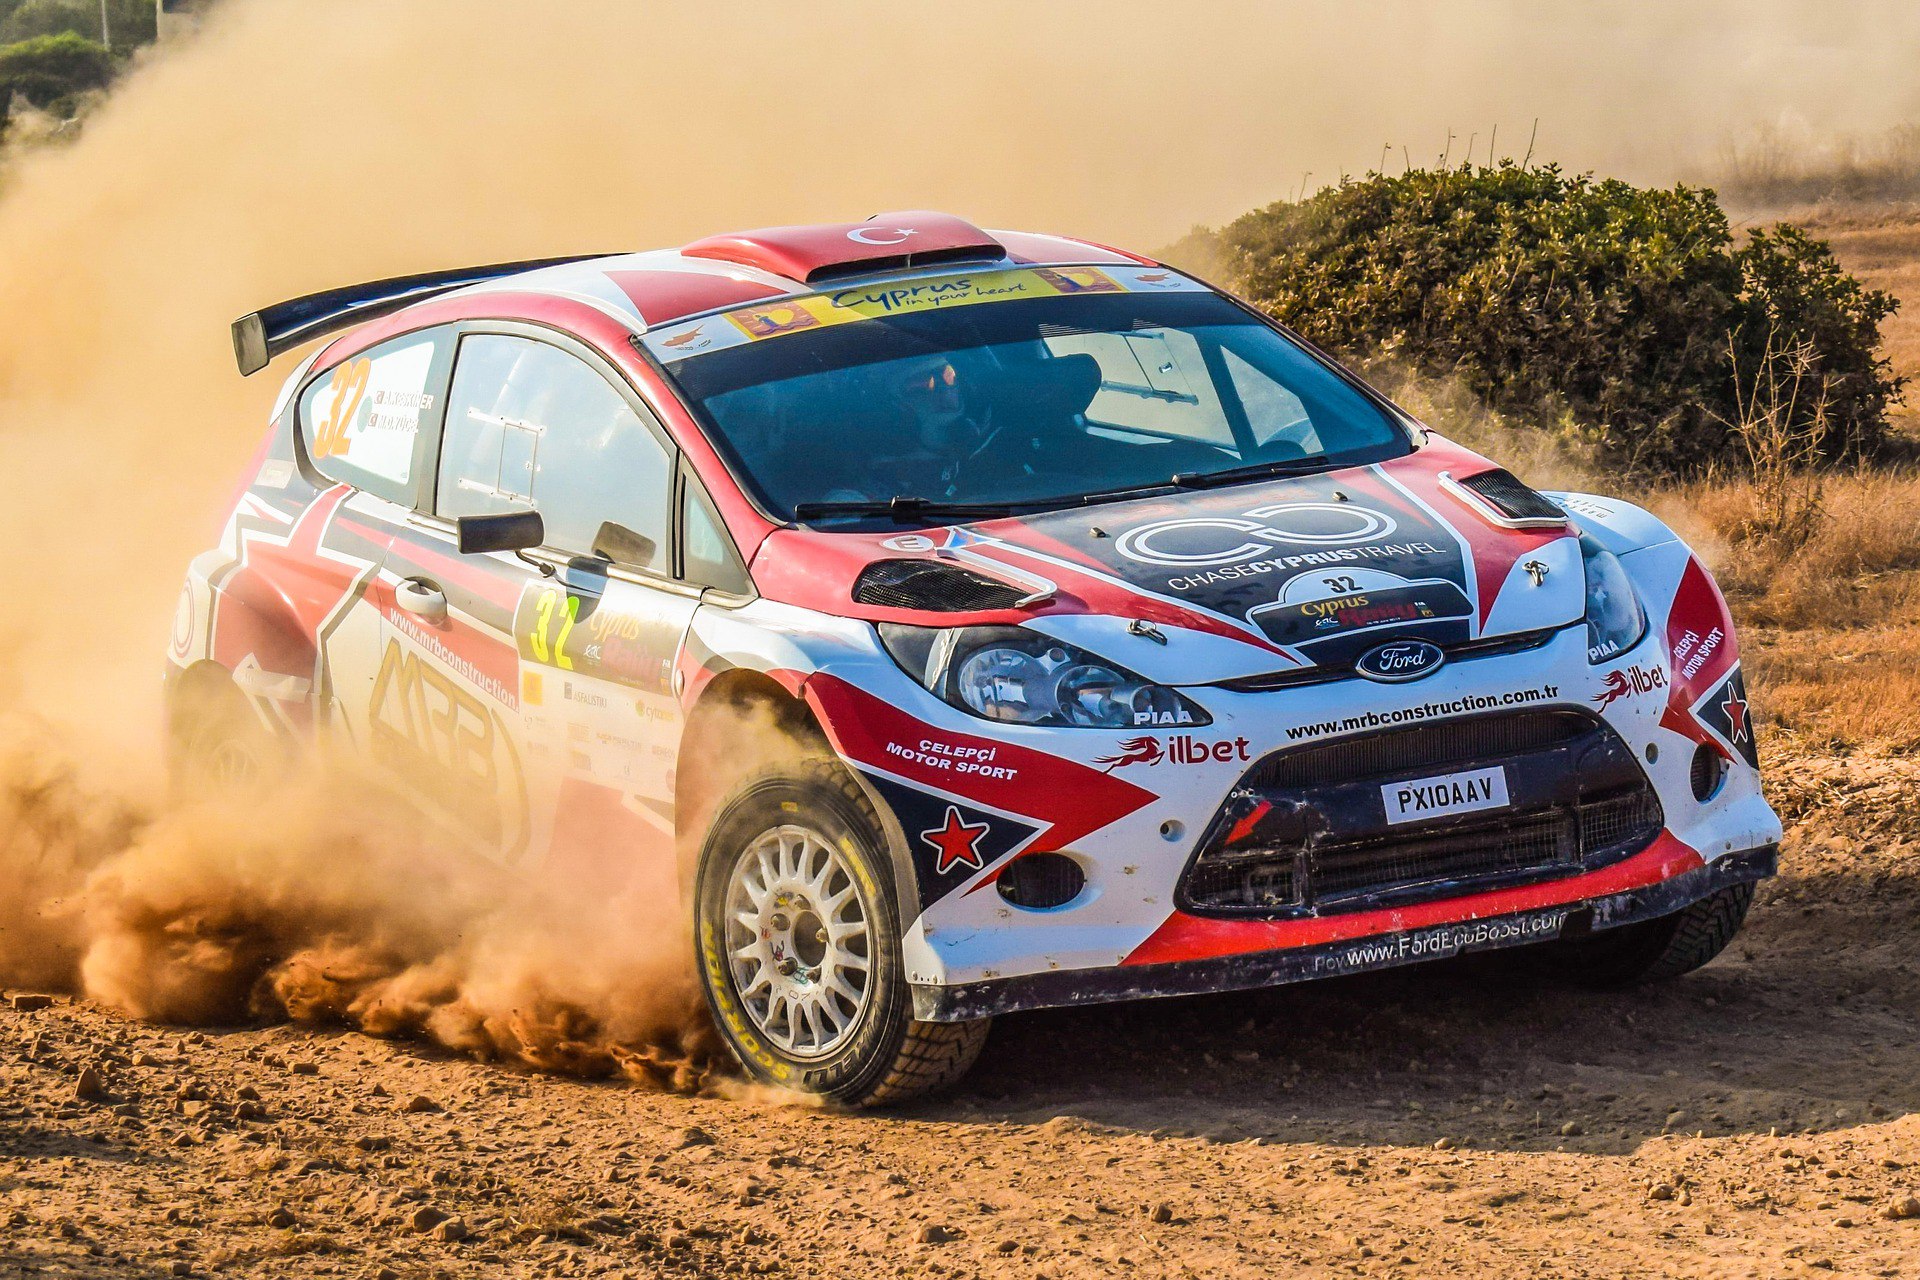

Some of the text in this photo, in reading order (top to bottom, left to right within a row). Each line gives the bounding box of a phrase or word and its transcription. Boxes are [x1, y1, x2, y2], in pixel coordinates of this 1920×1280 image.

[831, 279, 972, 311] Cyprus
[906, 283, 1027, 307] in your heart
[313, 357, 371, 459] 32
[1167, 542, 1447, 591] CHASECYPRUSTRAVEL
[1322, 576, 1364, 593] 32
[1300, 595, 1369, 618] Cyprus
[531, 589, 579, 671] 32
[590, 610, 639, 642] Cyprus
[1380, 646, 1426, 671] Ford
[1588, 640, 1620, 661] PIAA
[1682, 626, 1725, 680] MOTOR SPORT
[1628, 664, 1668, 696] ilbet
[1133, 709, 1194, 725] PIAA
[1286, 684, 1558, 740] www.mrbconstruction.com.tr
[886, 742, 1017, 780] MOTOR SPORT
[919, 739, 996, 762] ÇELEPÇİ
[1168, 736, 1251, 764] ilbet
[1397, 777, 1492, 814] PX10AAV
